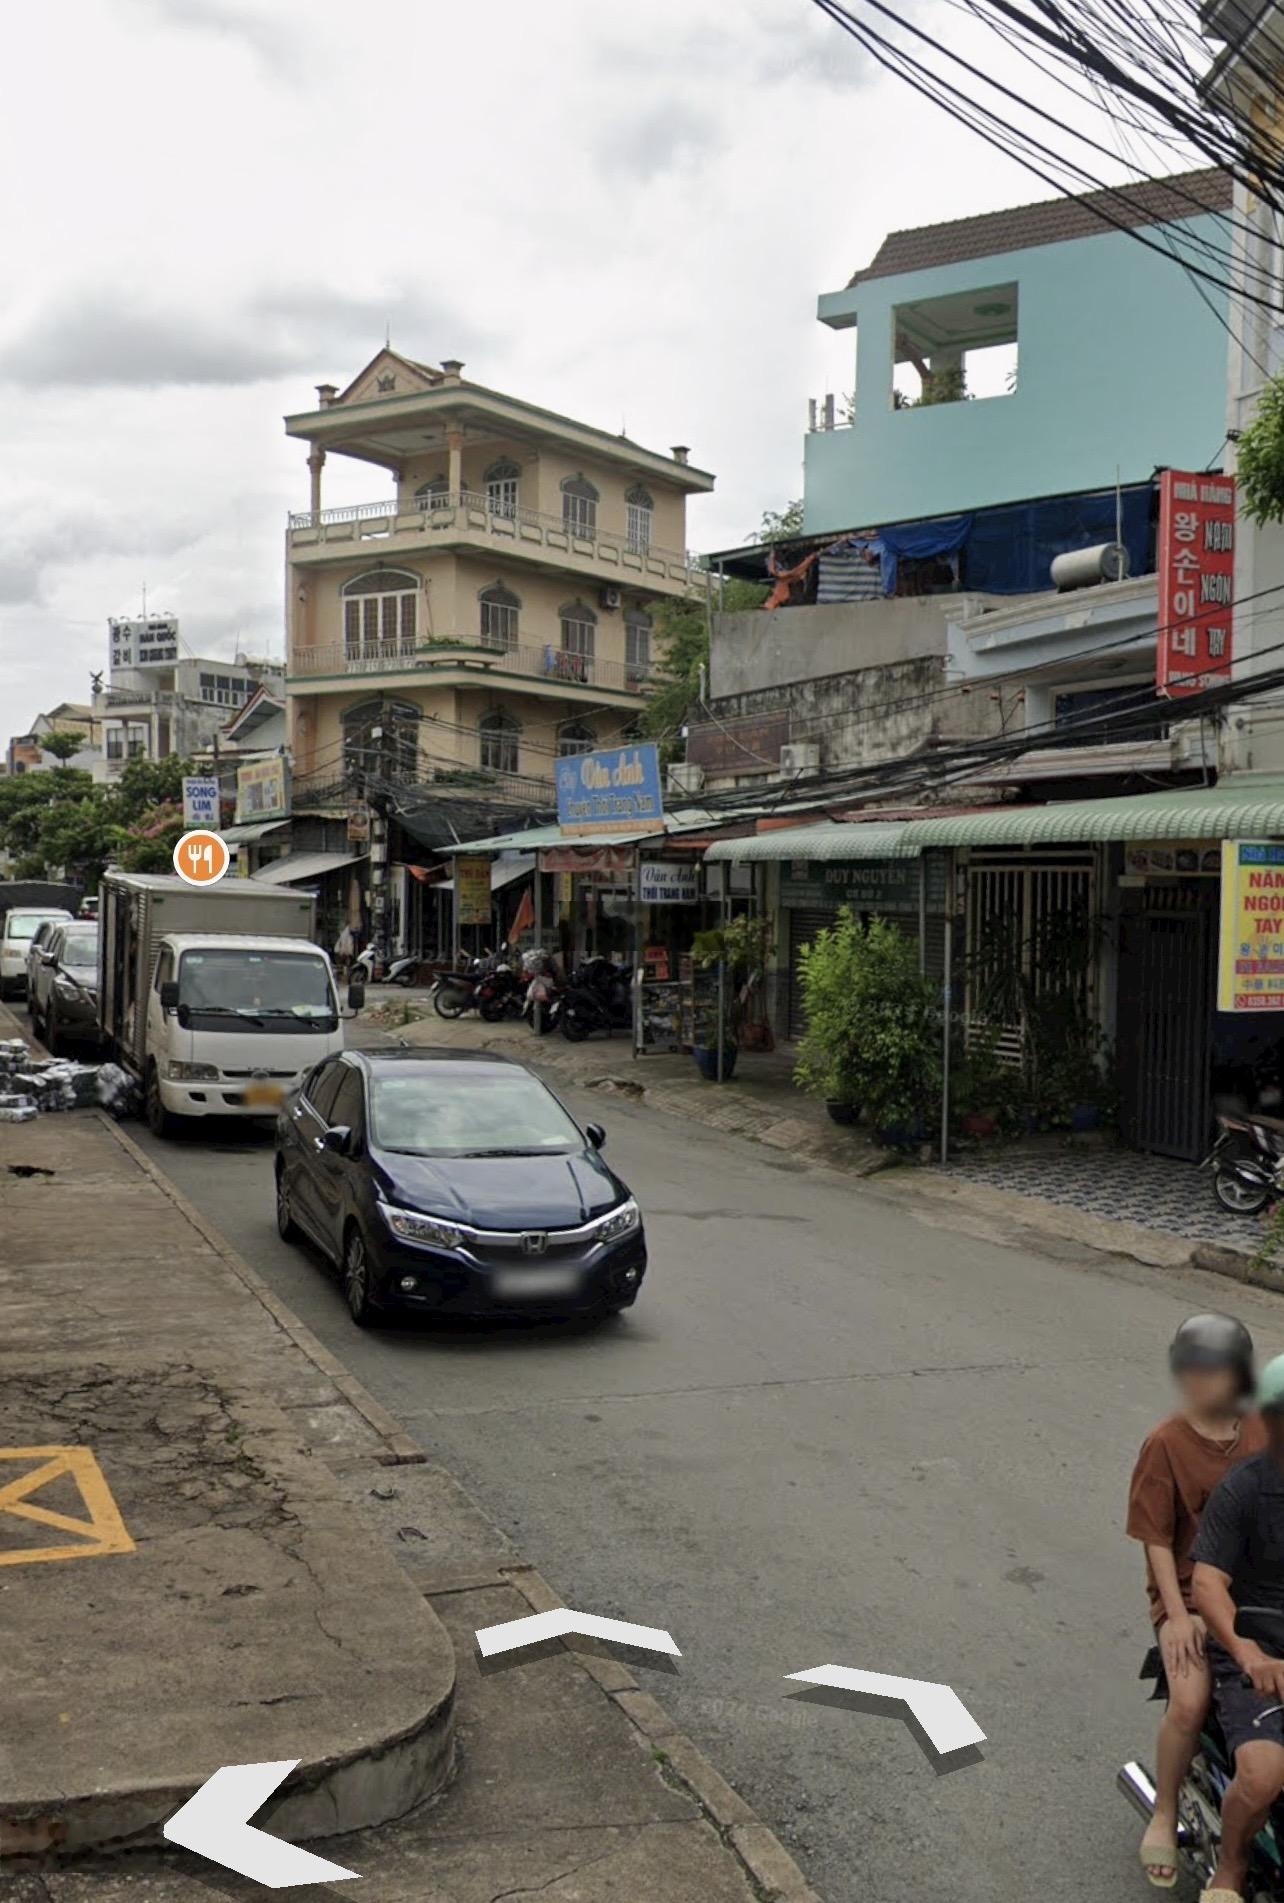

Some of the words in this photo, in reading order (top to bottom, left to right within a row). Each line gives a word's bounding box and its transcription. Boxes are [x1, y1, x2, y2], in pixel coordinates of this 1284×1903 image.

[186, 786, 217, 798] SONG
[192, 801, 212, 812] LIM
[1254, 919, 1282, 934] TAY
